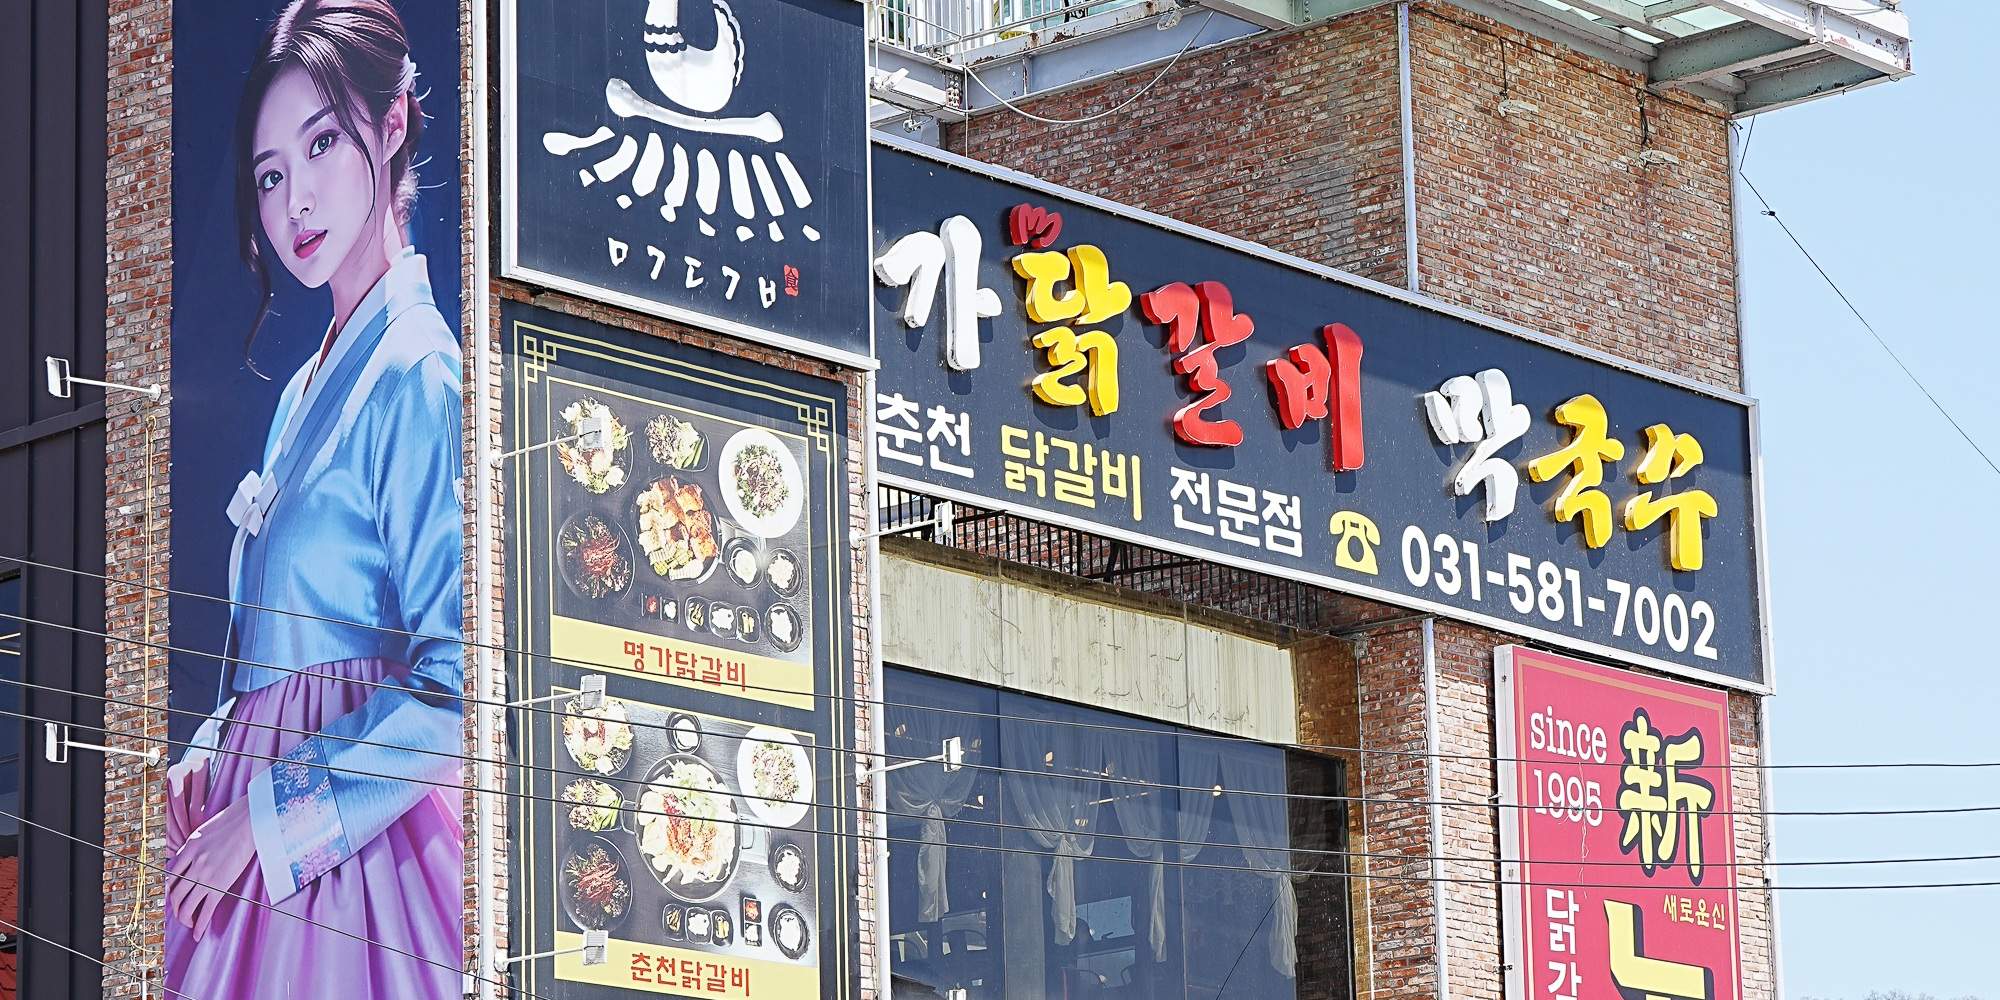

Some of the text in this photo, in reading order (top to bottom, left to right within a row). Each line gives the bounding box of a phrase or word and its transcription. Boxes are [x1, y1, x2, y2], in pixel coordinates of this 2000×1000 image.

[1425, 368, 1718, 571] 막국수
[876, 393, 1719, 661] 춘천 닭갈비 전문점 031-581-7002
[623, 640, 748, 692] 명가닭갈비
[1530, 706, 1608, 764] since
[1533, 769, 1604, 827] 1995
[1616, 706, 1716, 887] 新
[630, 952, 751, 997] 춘천닭갈비
